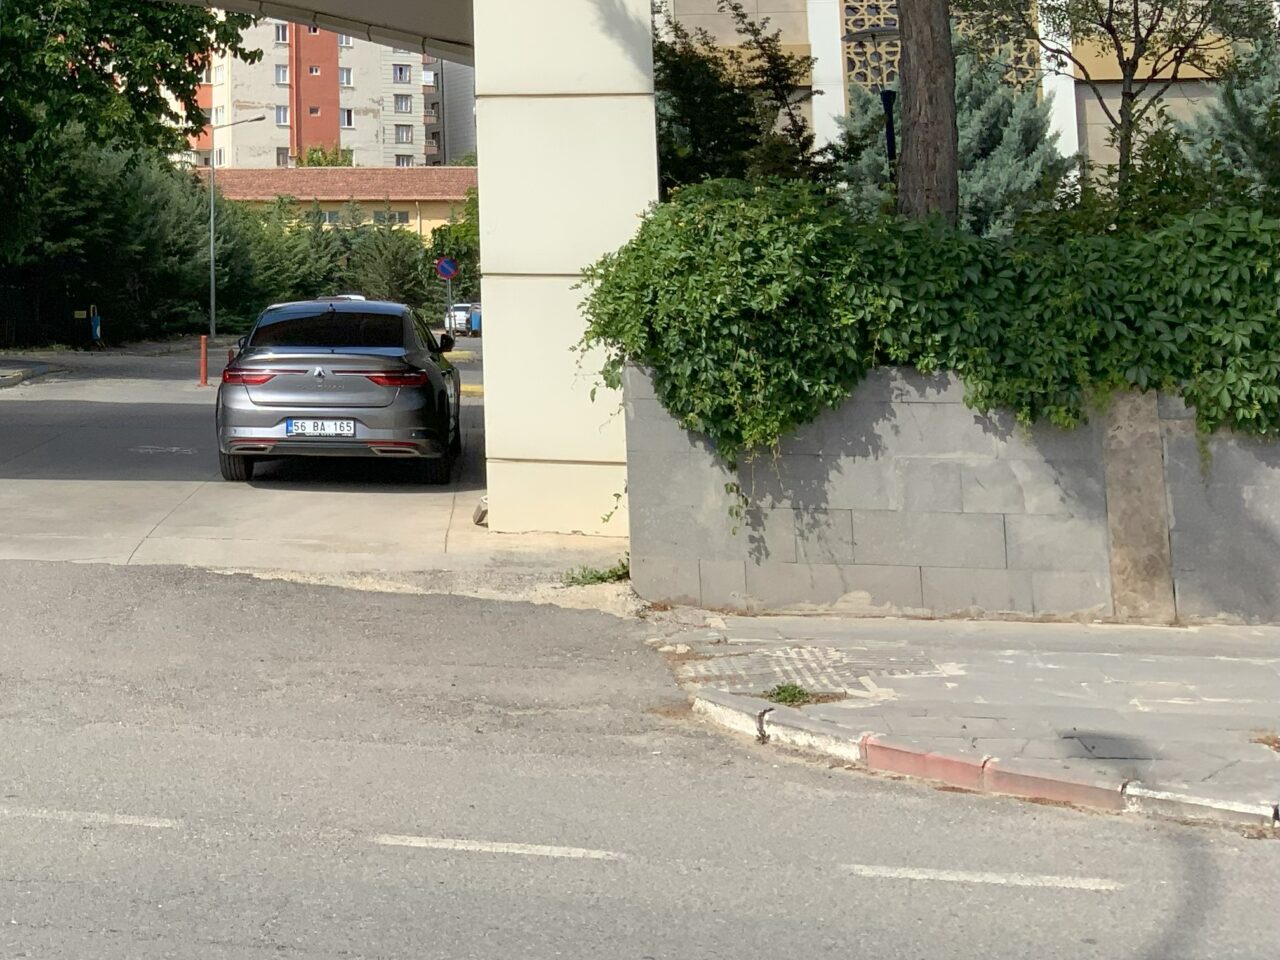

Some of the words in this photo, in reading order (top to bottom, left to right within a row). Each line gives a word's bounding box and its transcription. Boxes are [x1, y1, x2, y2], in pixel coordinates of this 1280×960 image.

[293, 421, 307, 432] 56
[312, 421, 326, 432] BA
[334, 421, 352, 432] 165
